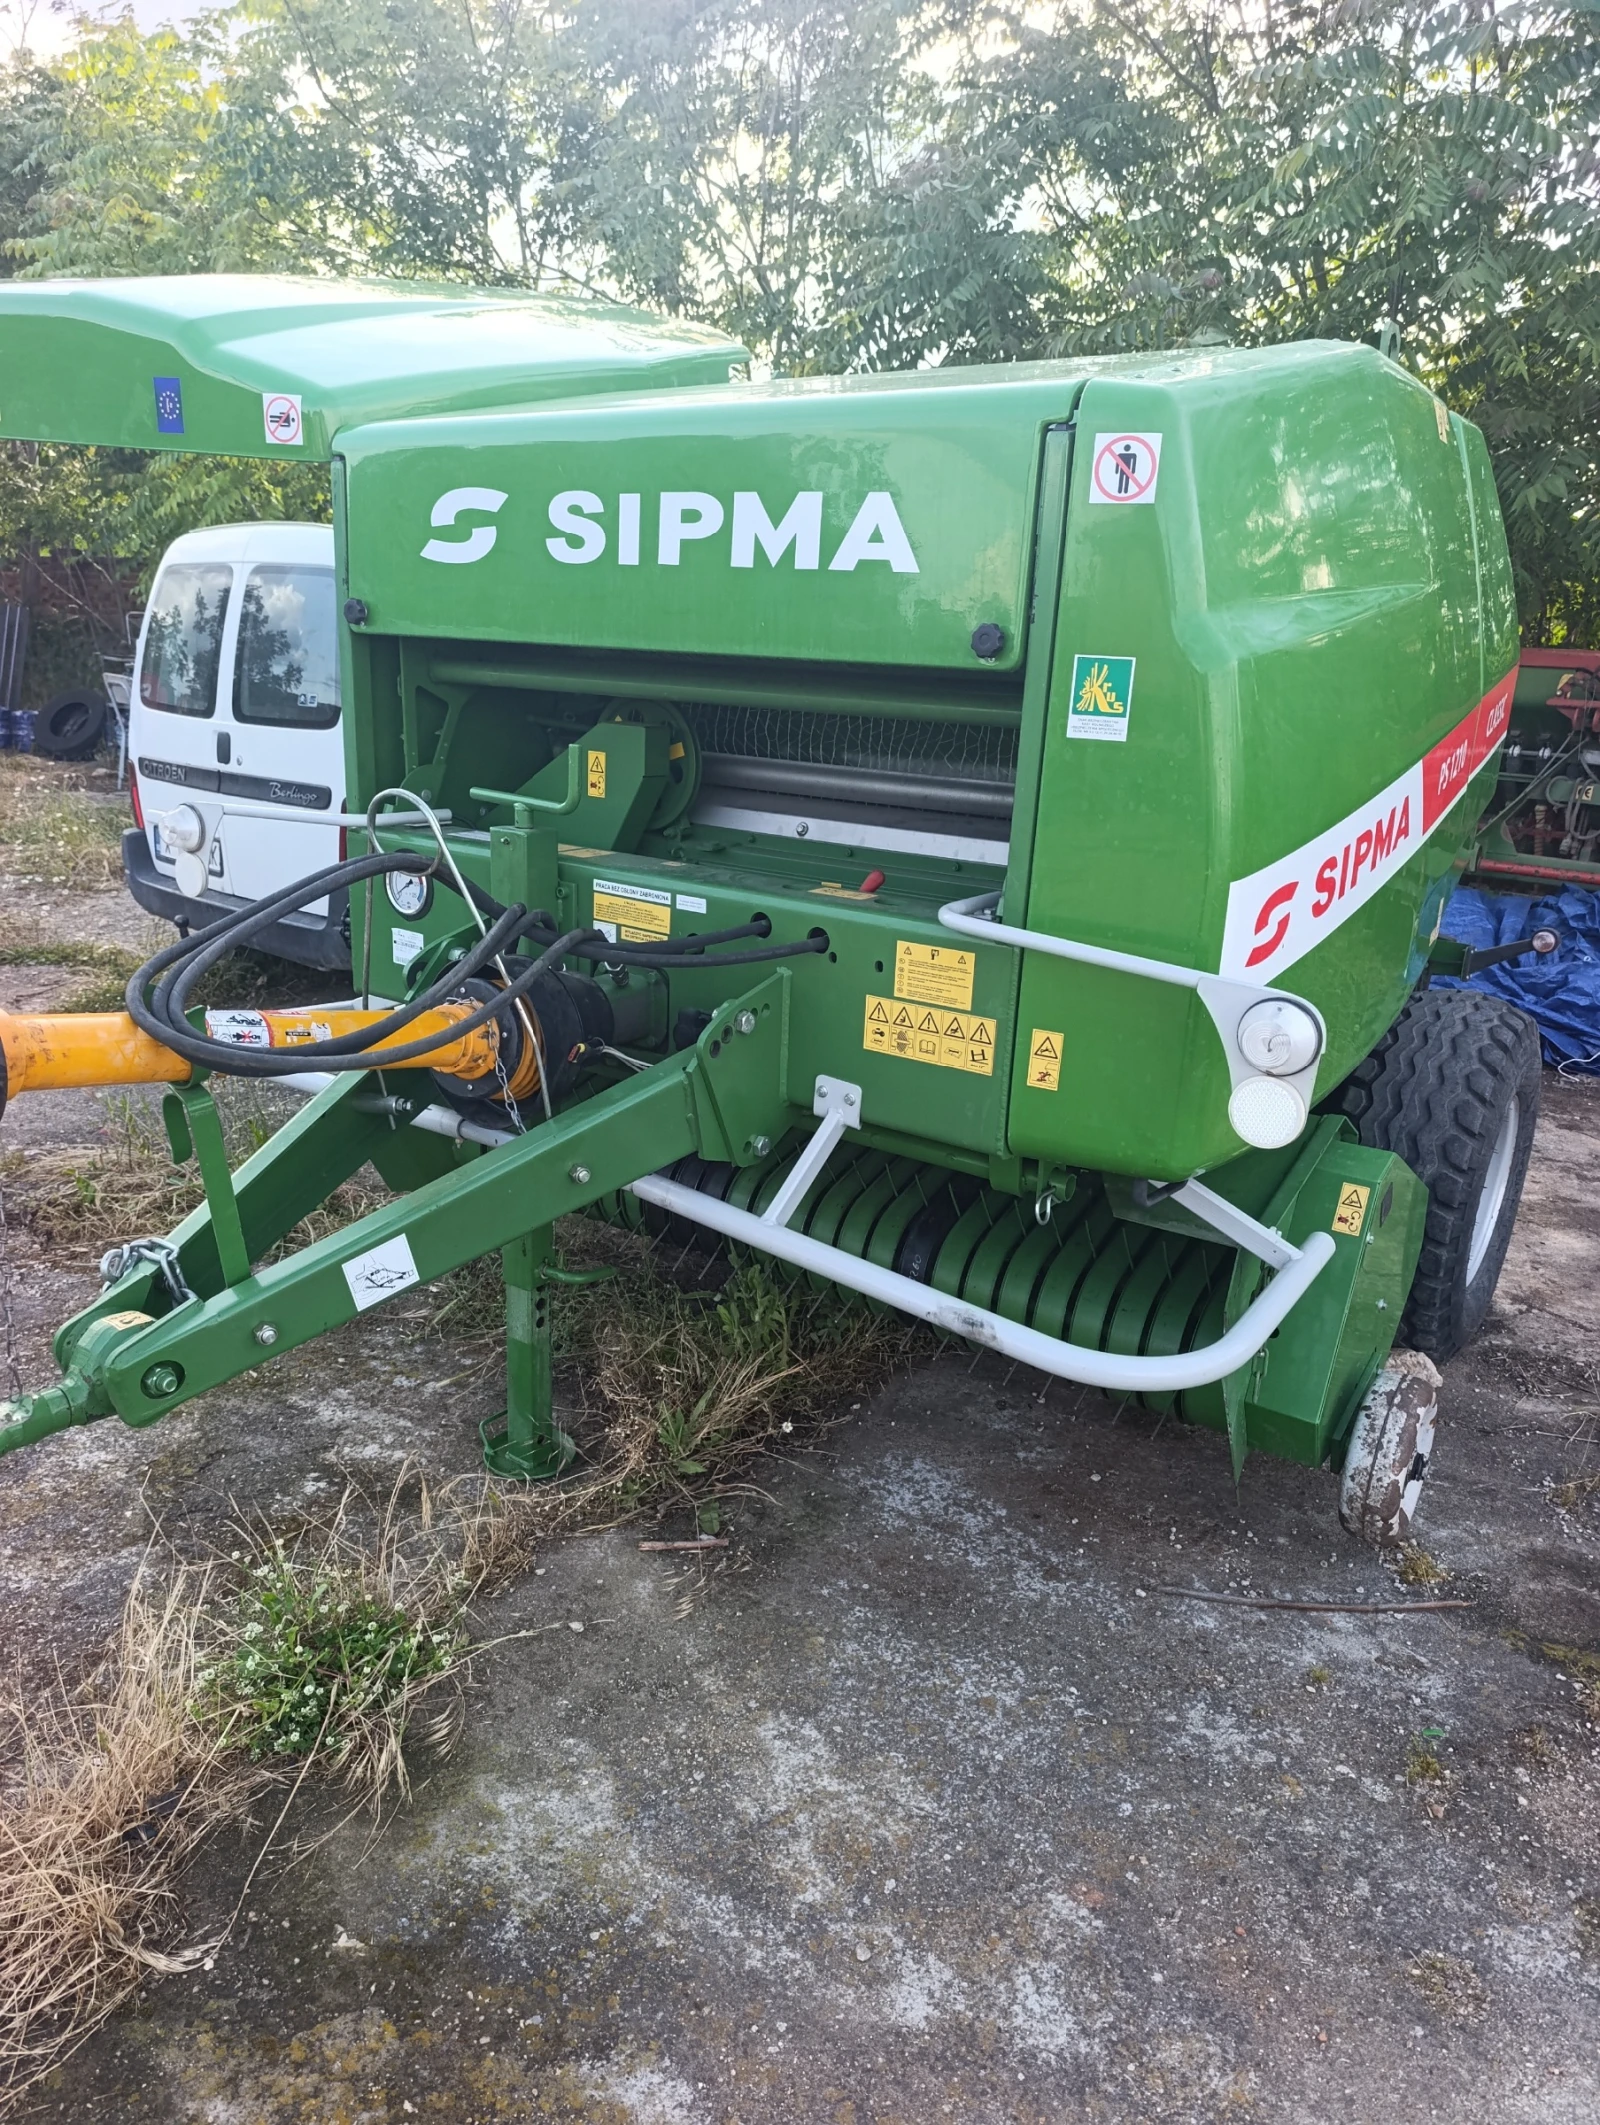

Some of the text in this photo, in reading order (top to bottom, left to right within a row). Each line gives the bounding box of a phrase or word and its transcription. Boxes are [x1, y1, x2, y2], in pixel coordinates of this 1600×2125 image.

[546, 490, 920, 573] SIPMA
[269, 782, 317, 804] Berlingo
[1438, 757, 1451, 796] PS
[1312, 795, 1409, 918] SIPMA
